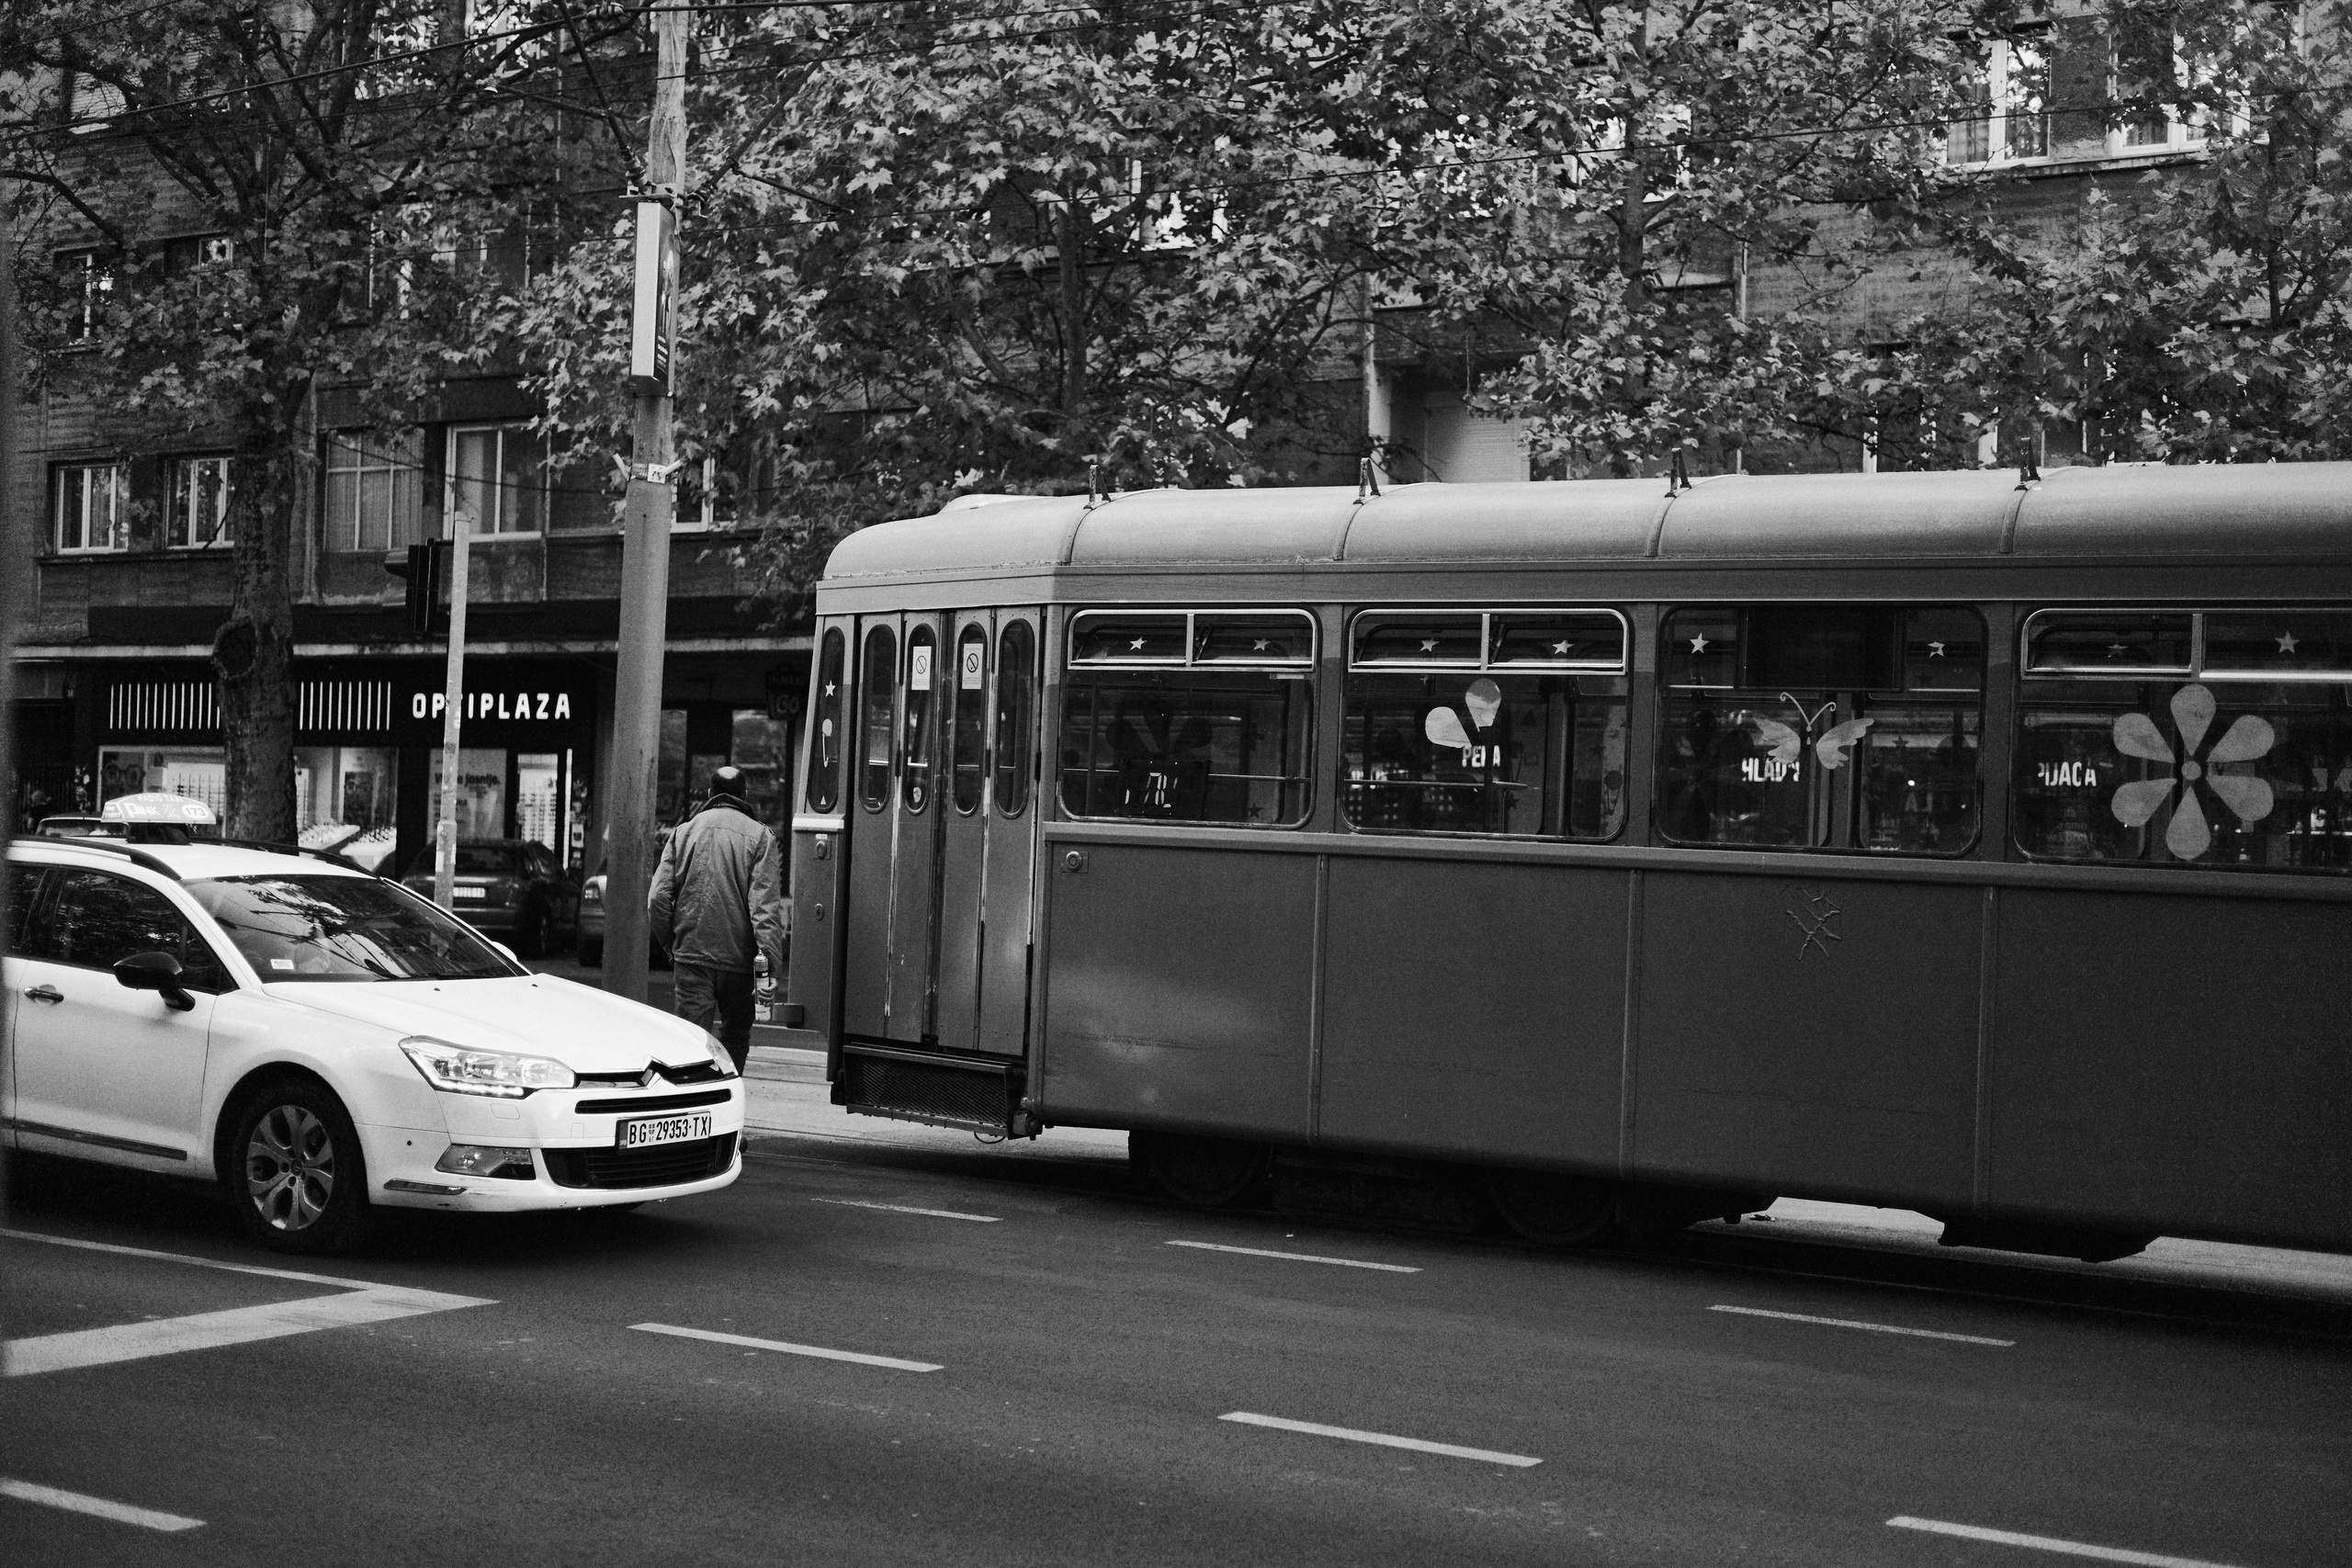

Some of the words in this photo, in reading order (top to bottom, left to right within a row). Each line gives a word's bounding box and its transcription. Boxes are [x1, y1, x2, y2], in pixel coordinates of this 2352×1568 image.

[413, 693, 571, 719] OPIPLAZA
[185, 807, 206, 817] 173
[629, 1123, 647, 1145] BG
